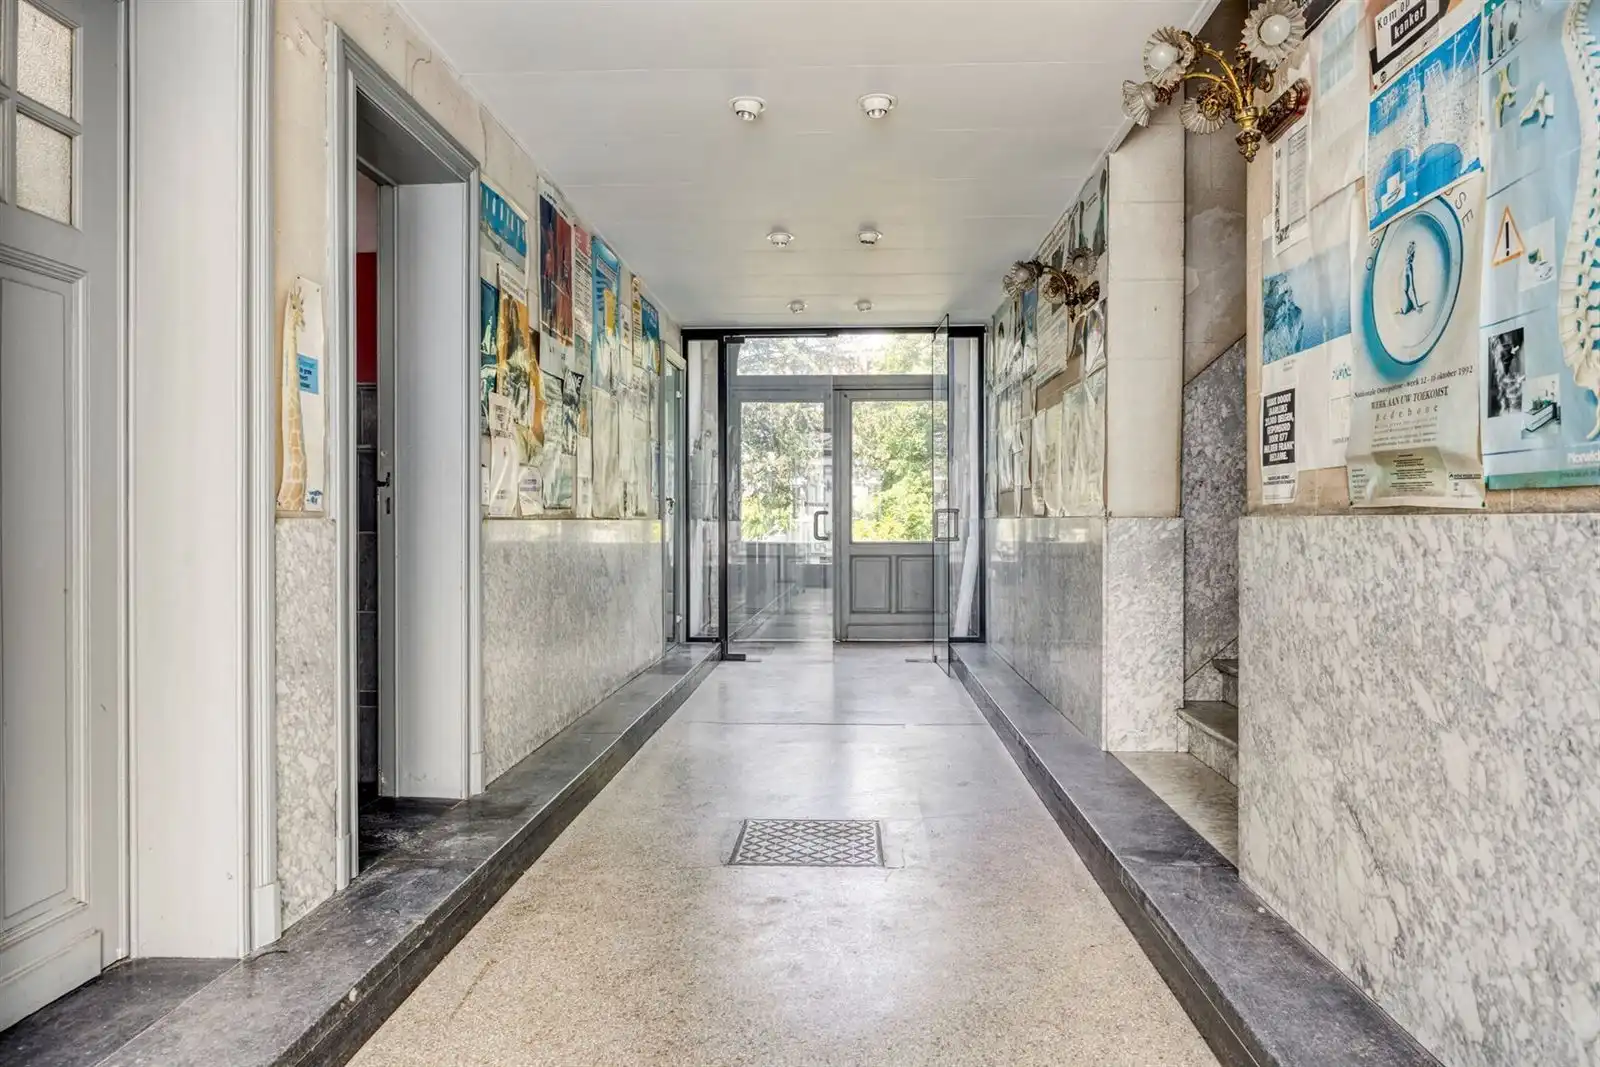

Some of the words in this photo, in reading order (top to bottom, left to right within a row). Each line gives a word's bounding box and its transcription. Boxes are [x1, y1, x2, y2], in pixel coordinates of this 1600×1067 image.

[1377, 9, 1398, 30] Kom
[1394, 5, 1425, 40] kanker
[1458, 365, 1473, 376] 1992
[1413, 385, 1449, 402] TOEKOMST
